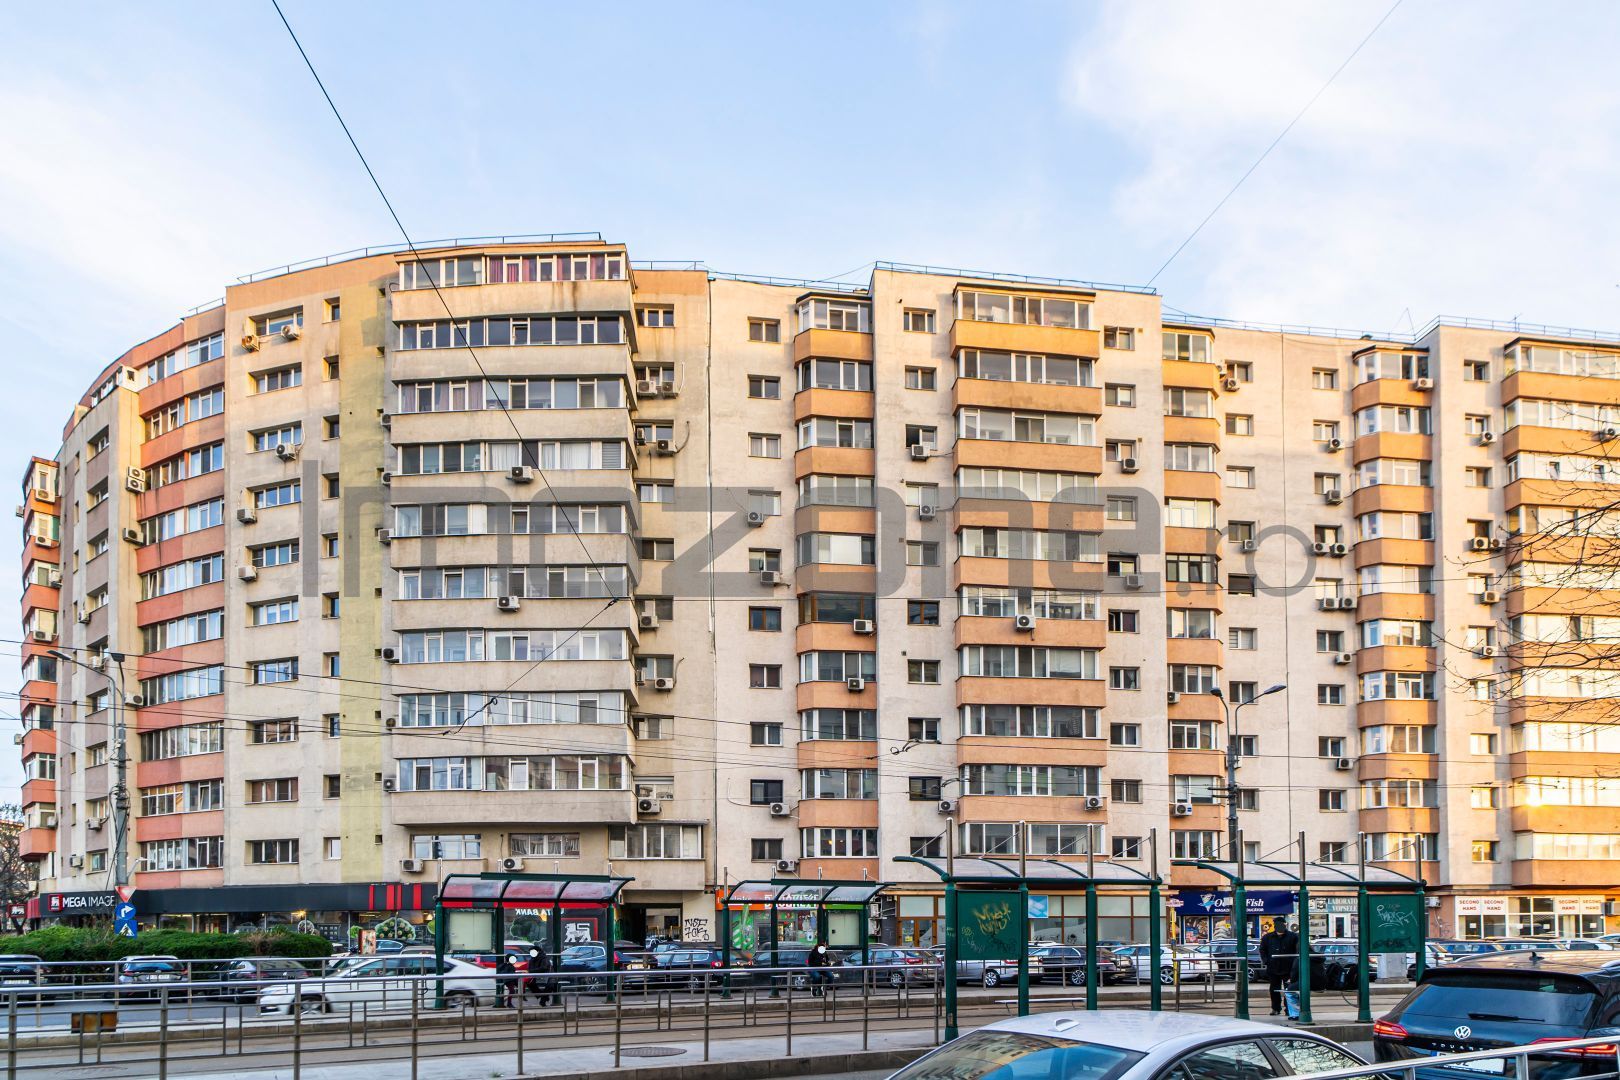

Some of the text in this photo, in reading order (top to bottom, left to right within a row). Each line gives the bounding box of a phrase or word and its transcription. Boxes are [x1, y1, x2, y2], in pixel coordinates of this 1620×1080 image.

[62, 895, 115, 908] MEGA IMAGE
[1246, 898, 1264, 907] Fish
[1328, 898, 1359, 906] LABORATO
